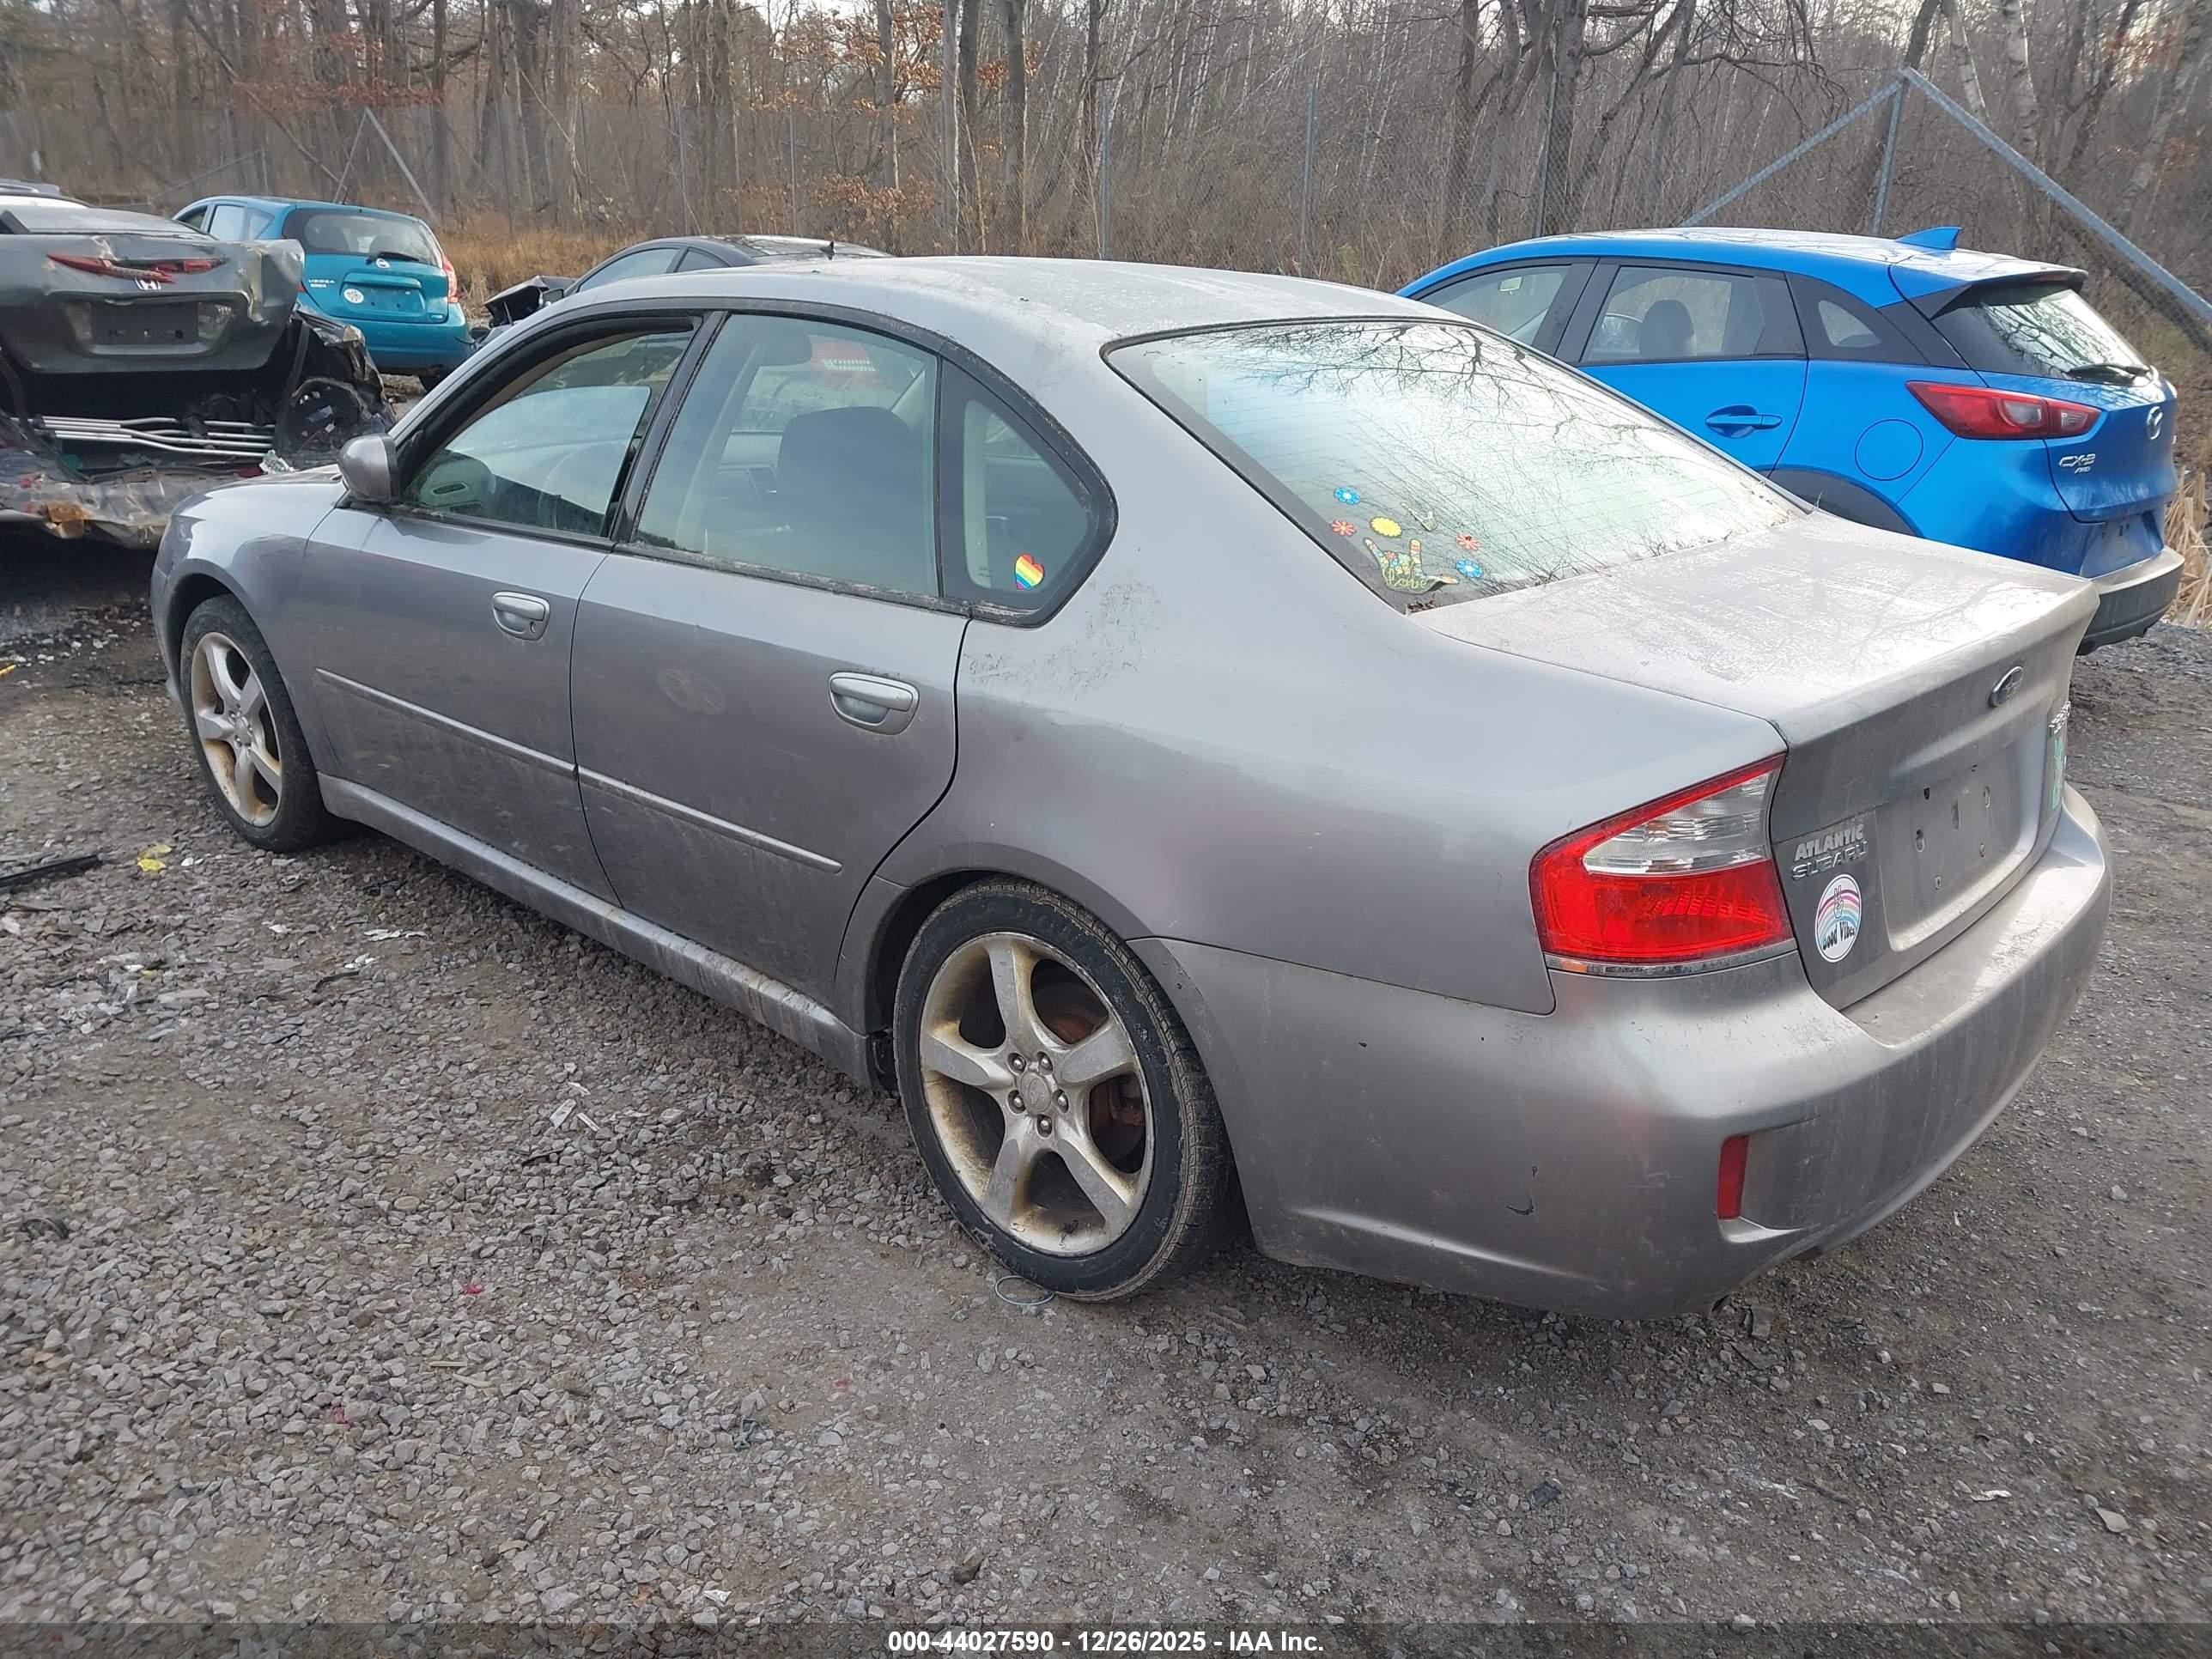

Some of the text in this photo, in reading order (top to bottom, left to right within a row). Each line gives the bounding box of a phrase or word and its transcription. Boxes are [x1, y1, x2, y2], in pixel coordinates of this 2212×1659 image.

[2058, 453, 2096, 467] CX-3
[1794, 823, 1865, 861] ATLANTIC
[1792, 839, 1869, 880] SUBARU
[1822, 921, 1856, 951] Good Vibes
